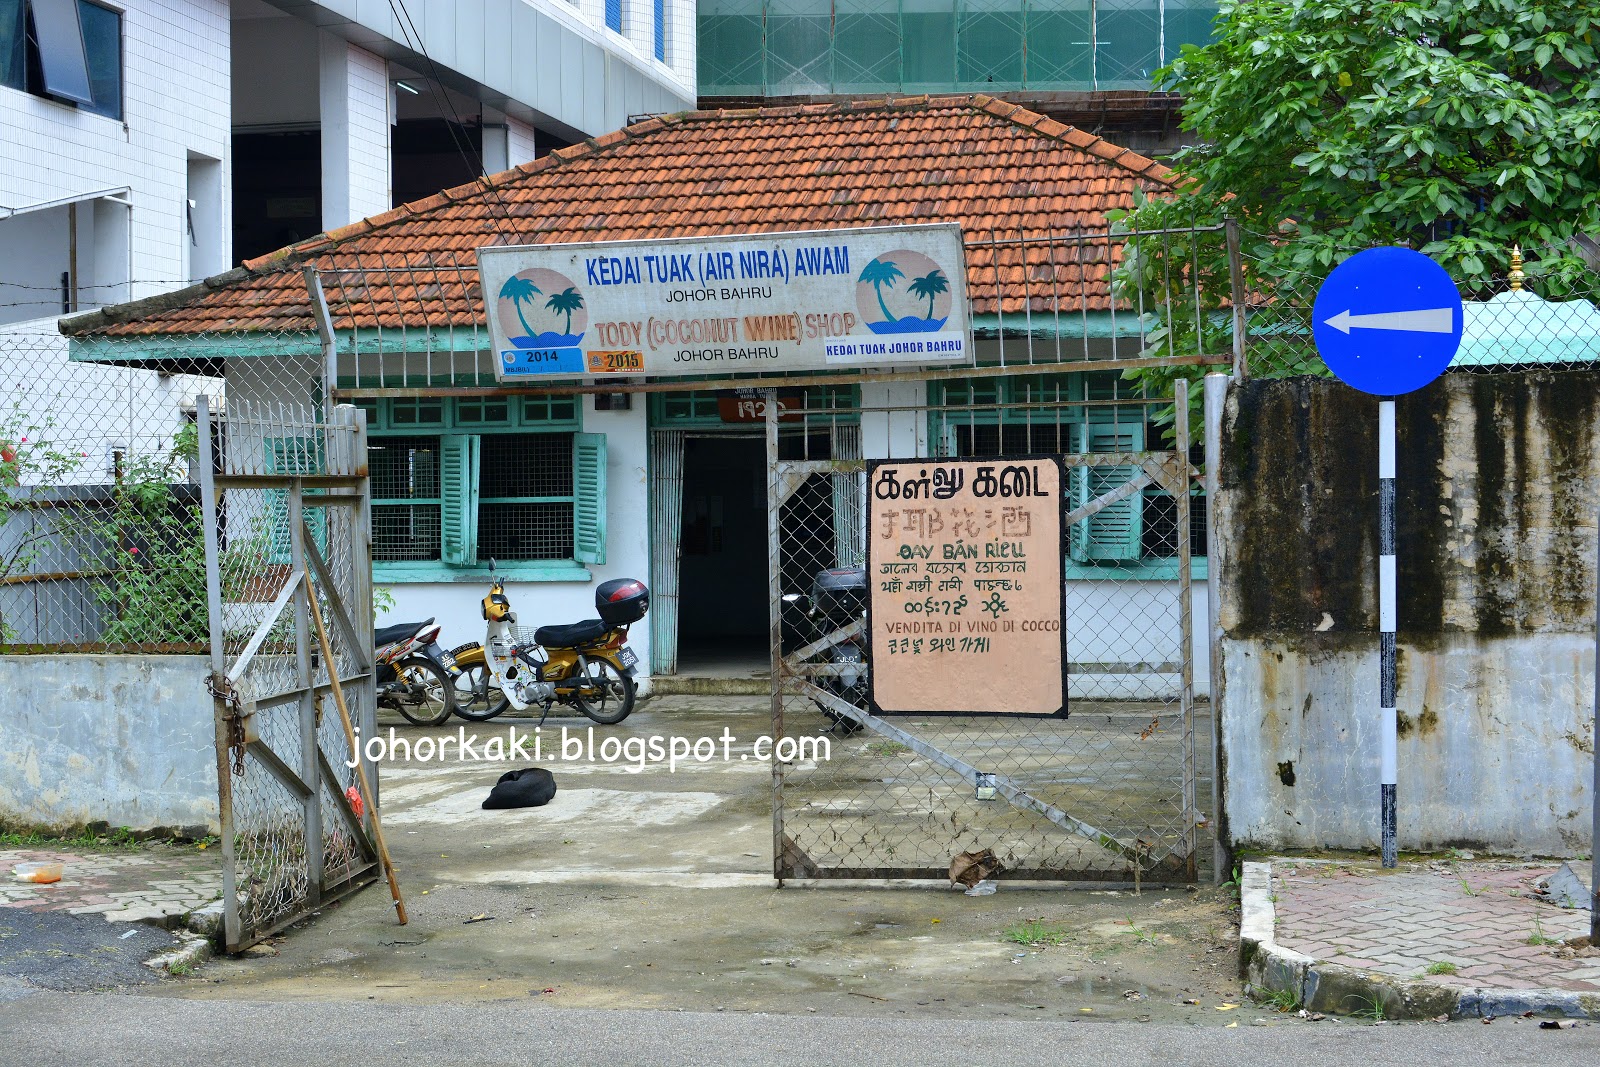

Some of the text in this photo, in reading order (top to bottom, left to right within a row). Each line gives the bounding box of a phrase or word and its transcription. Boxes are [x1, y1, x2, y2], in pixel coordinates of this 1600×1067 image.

[586, 245, 850, 288] KEDAI TUAK (AIR NIRA) AWAM
[665, 286, 773, 303] JOHOR BAHRU
[594, 311, 857, 351] TODY (COCONUT WINE) SHOP
[526, 350, 559, 363] 2014
[673, 346, 779, 363] JOHOR BAHRU
[826, 340, 962, 356] KEDAI TUAK JOHOR BAHRU
[606, 353, 640, 368] 2015
[972, 465, 1050, 498] கடை
[885, 619, 1060, 634] VENDITA DI VINO DI COCCO
